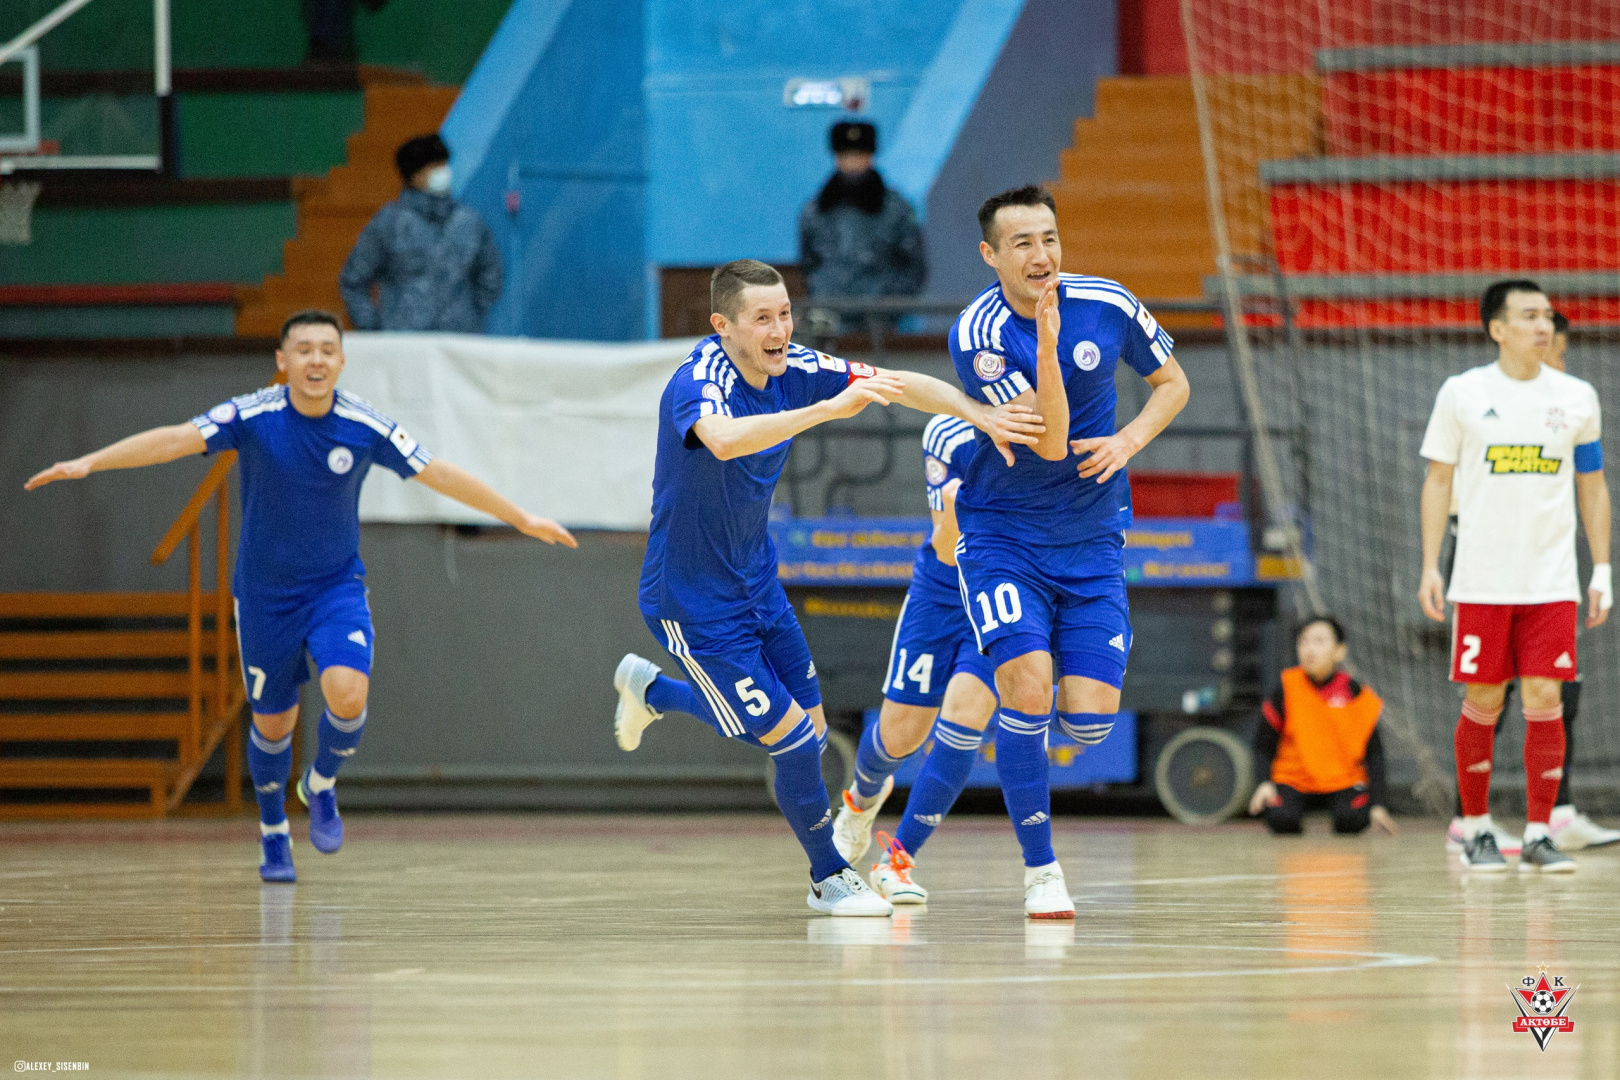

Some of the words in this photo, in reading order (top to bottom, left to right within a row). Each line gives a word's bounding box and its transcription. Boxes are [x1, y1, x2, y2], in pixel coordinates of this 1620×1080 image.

[977, 582, 1023, 633] 10
[892, 648, 934, 694] 14
[1459, 634, 1481, 675] 2
[248, 665, 267, 701] 7
[734, 676, 771, 717] 5
